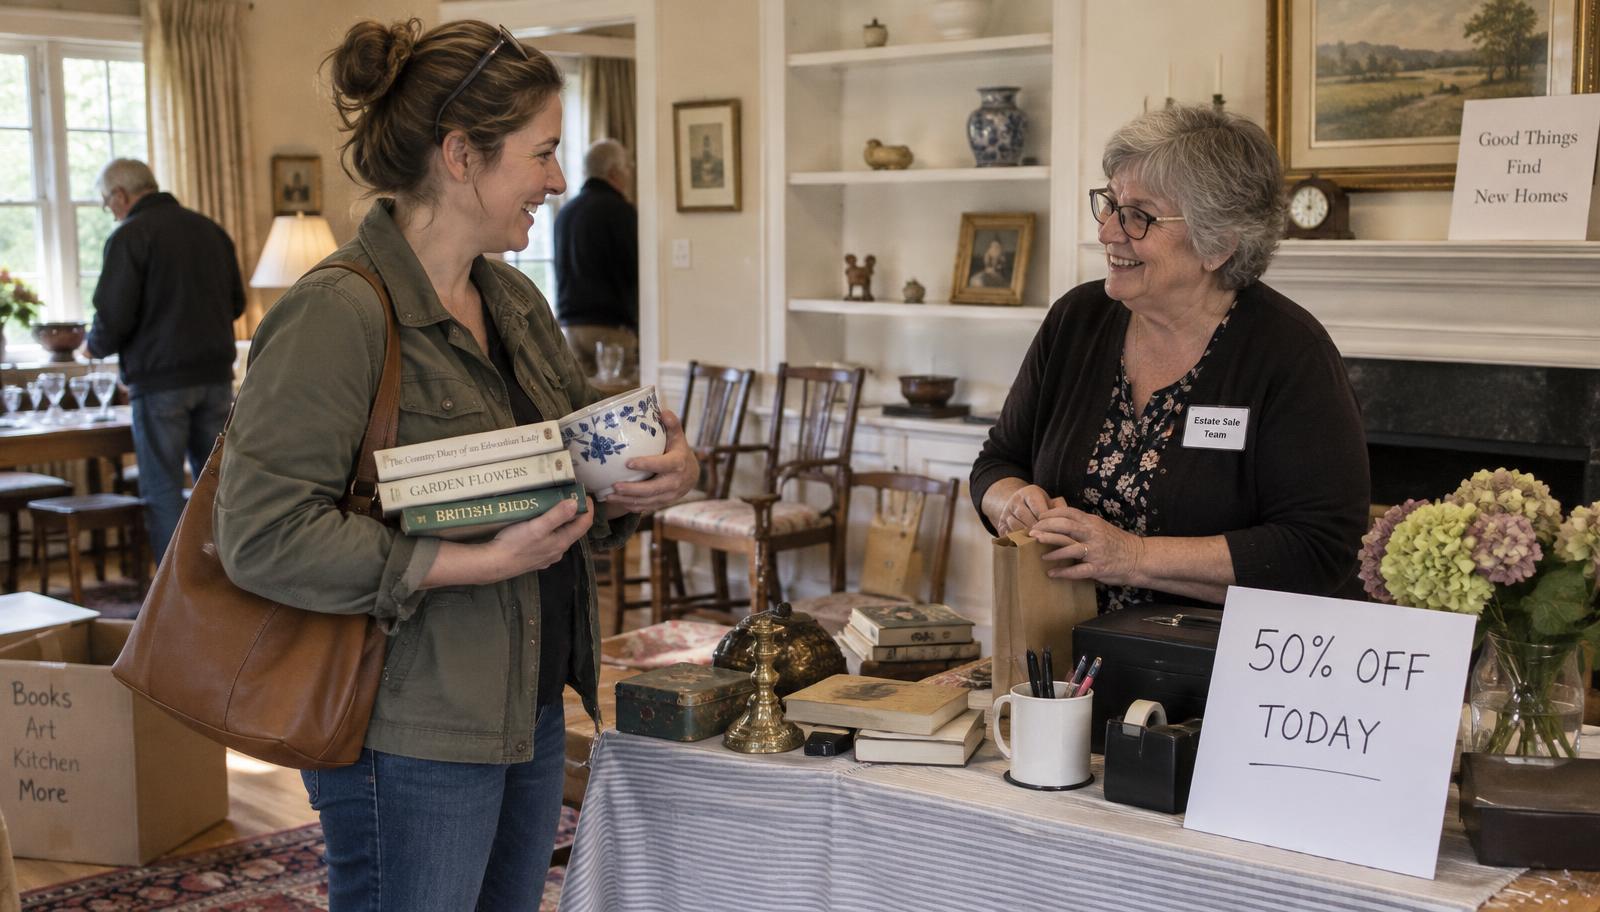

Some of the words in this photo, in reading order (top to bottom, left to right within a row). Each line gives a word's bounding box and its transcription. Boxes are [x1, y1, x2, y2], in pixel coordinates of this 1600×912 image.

[1478, 130, 1520, 147] Good
[1524, 130, 1578, 148] Things
[1507, 158, 1542, 174] Find
[1474, 188, 1509, 204] New
[1514, 188, 1568, 203] Homes
[1194, 416, 1220, 425] Estate
[1222, 417, 1240, 426] Sale
[1204, 430, 1227, 439] Team
[458, 443, 468, 456] of
[409, 478, 465, 496] GARDEN
[468, 466, 528, 486] FLOWERS
[435, 504, 493, 521] BRITISH
[1248, 628, 1335, 678] 50%
[1356, 648, 1430, 690] OFF
[11, 681, 72, 708] Books
[26, 717, 56, 739] Art
[1258, 704, 1381, 754] TODAY
[14, 747, 80, 772] Kitchen
[19, 778, 68, 803] More
